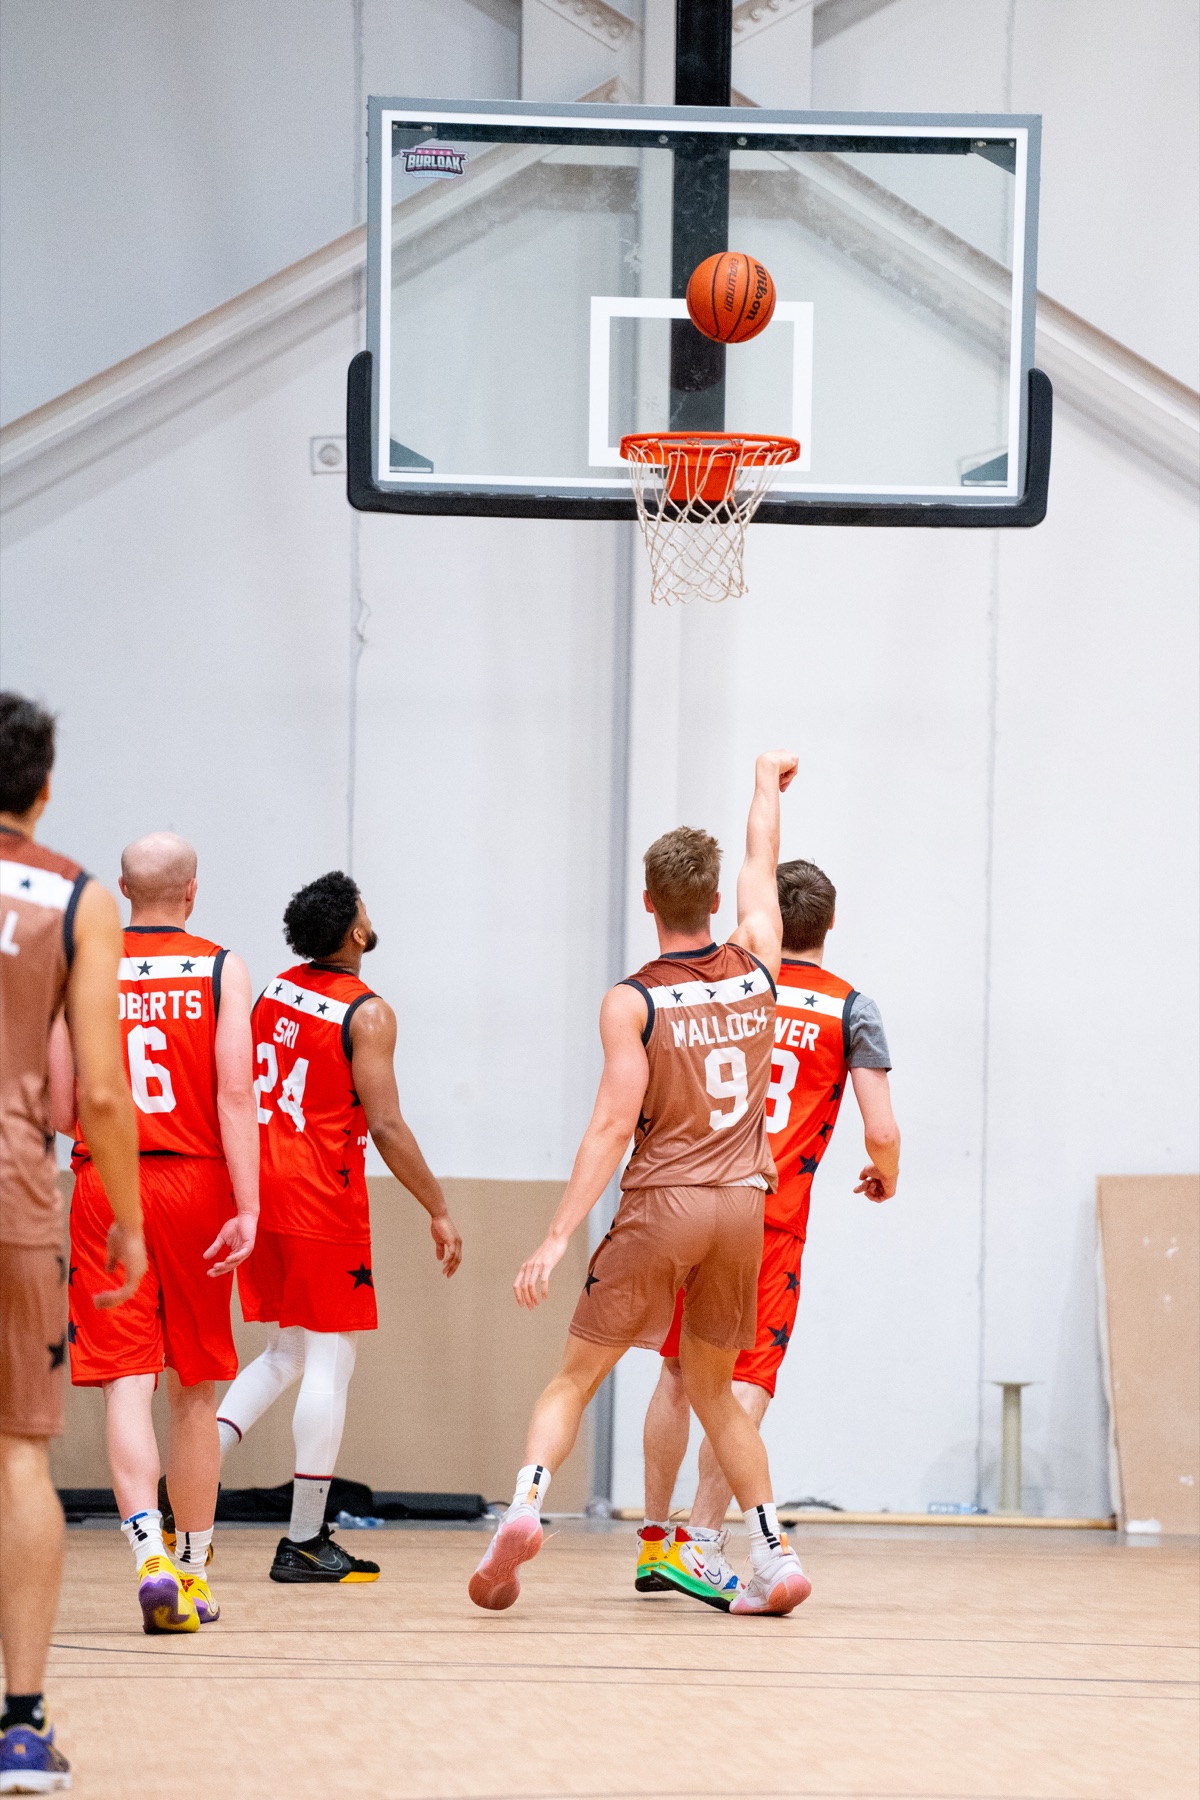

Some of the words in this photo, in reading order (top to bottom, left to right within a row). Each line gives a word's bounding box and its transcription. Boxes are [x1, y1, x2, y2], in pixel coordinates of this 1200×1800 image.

[407, 154, 461, 171] BURLOAK
[725, 257, 739, 312] EVOLUTION
[746, 264, 768, 321] Wilson
[273, 1016, 300, 1049] SRI
[671, 1006, 768, 1048] MALLOCH
[127, 1024, 177, 1114] 6
[253, 1042, 310, 1133] 24
[704, 1046, 750, 1131] 9
